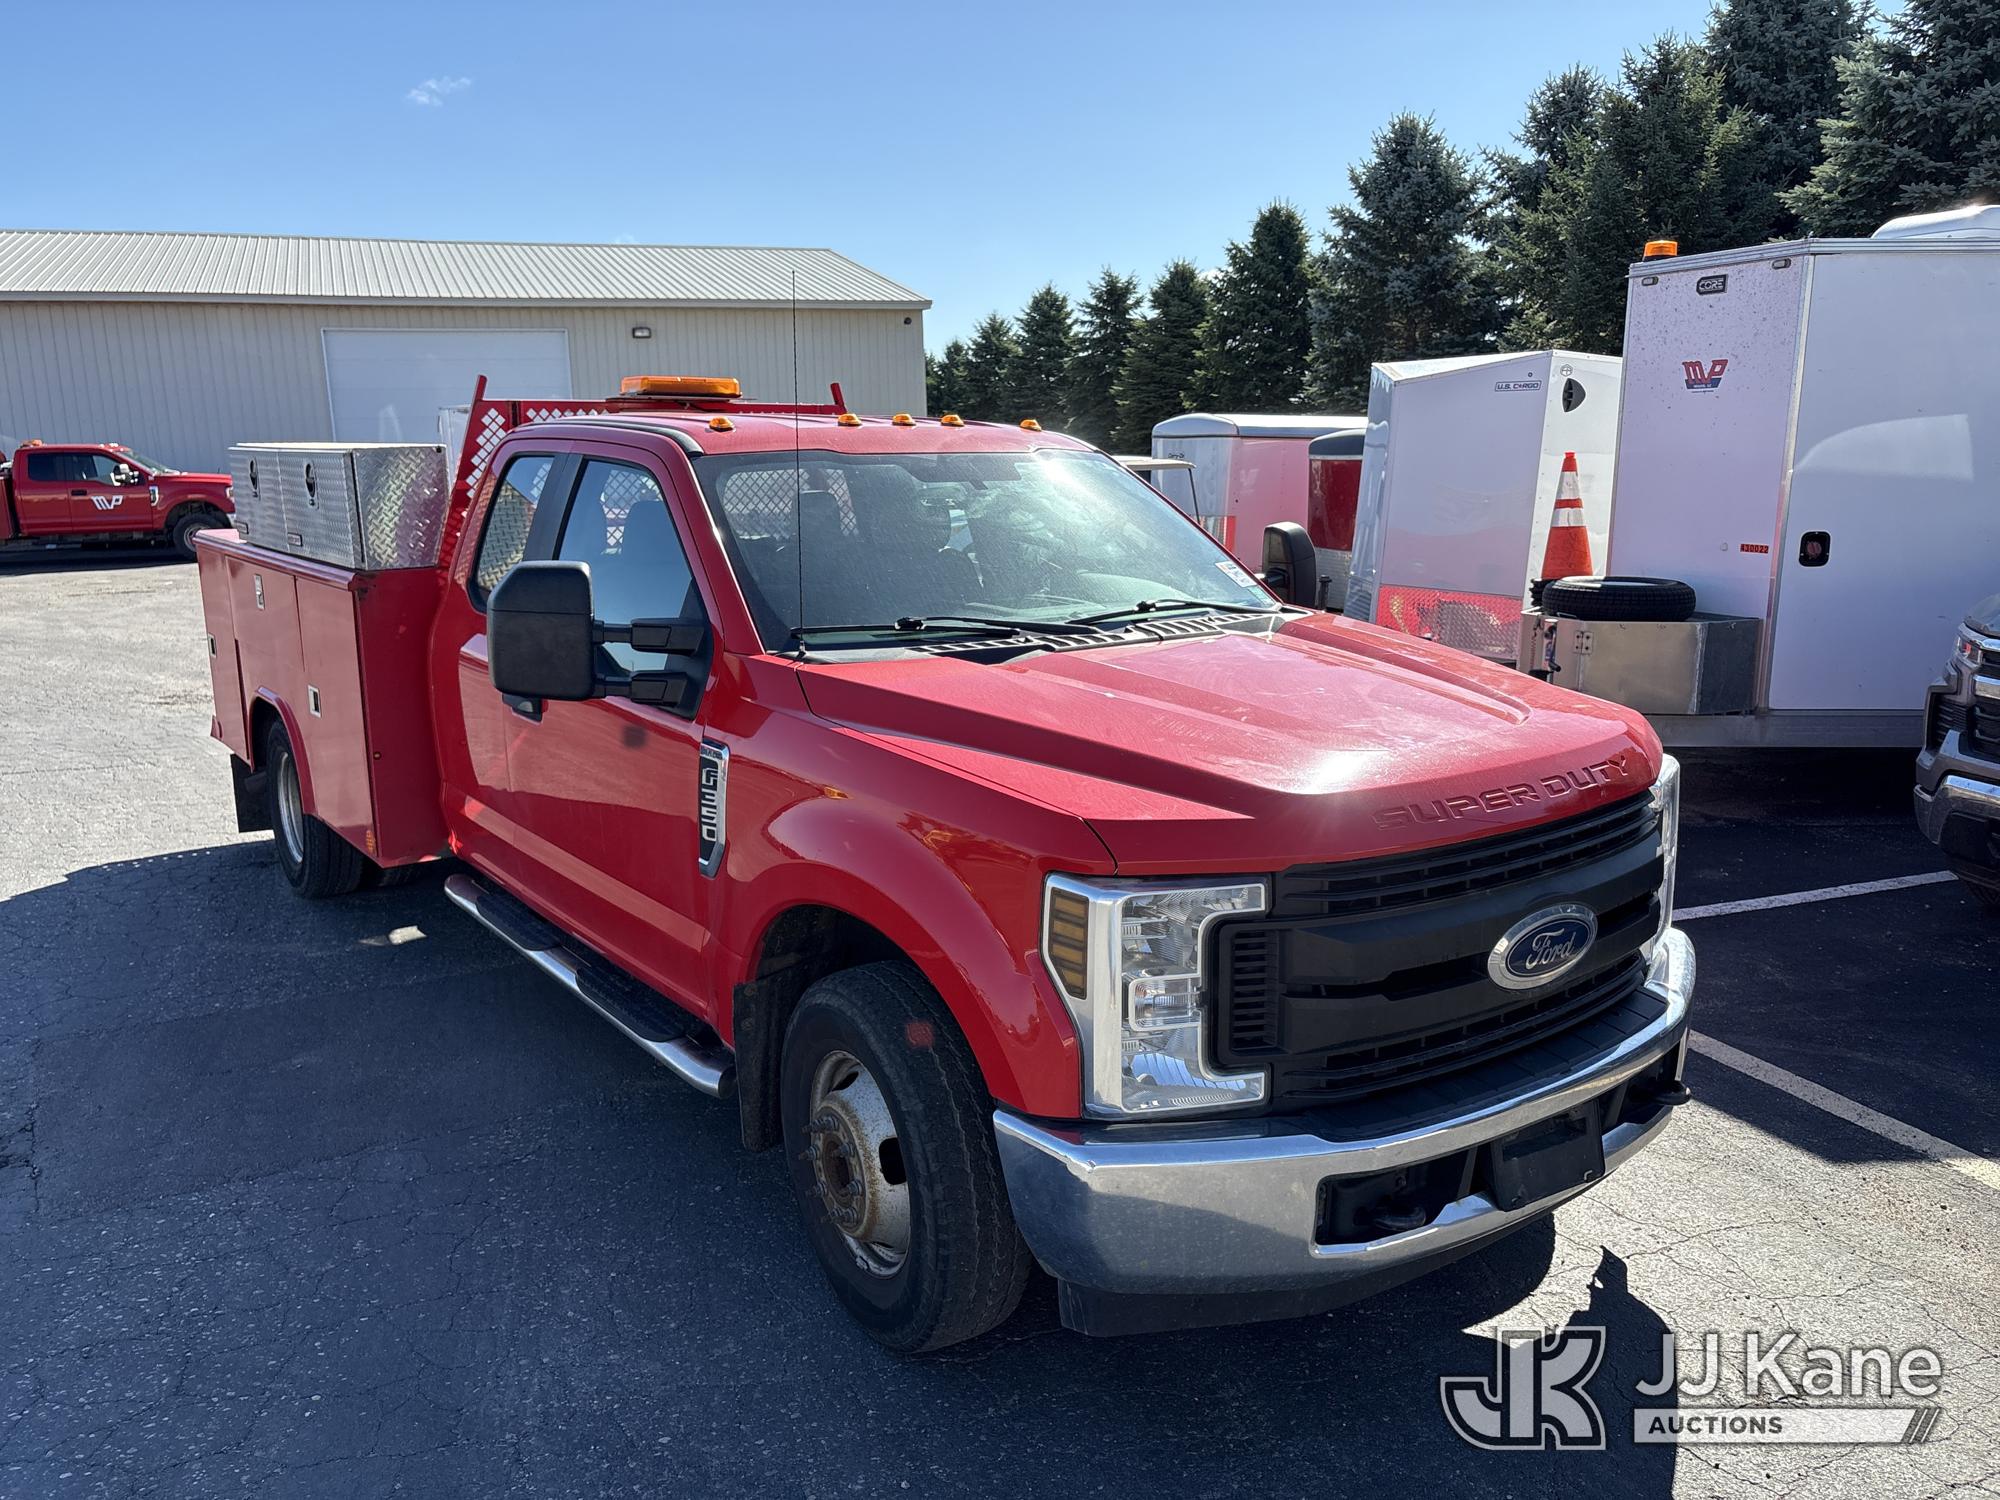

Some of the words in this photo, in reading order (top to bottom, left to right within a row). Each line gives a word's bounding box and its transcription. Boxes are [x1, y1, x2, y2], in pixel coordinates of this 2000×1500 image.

[1698, 277, 1725, 291] CORE
[1371, 783, 1541, 831] SUPER
[1540, 755, 1628, 798] DUTY
[1525, 928, 1579, 970] Ford
